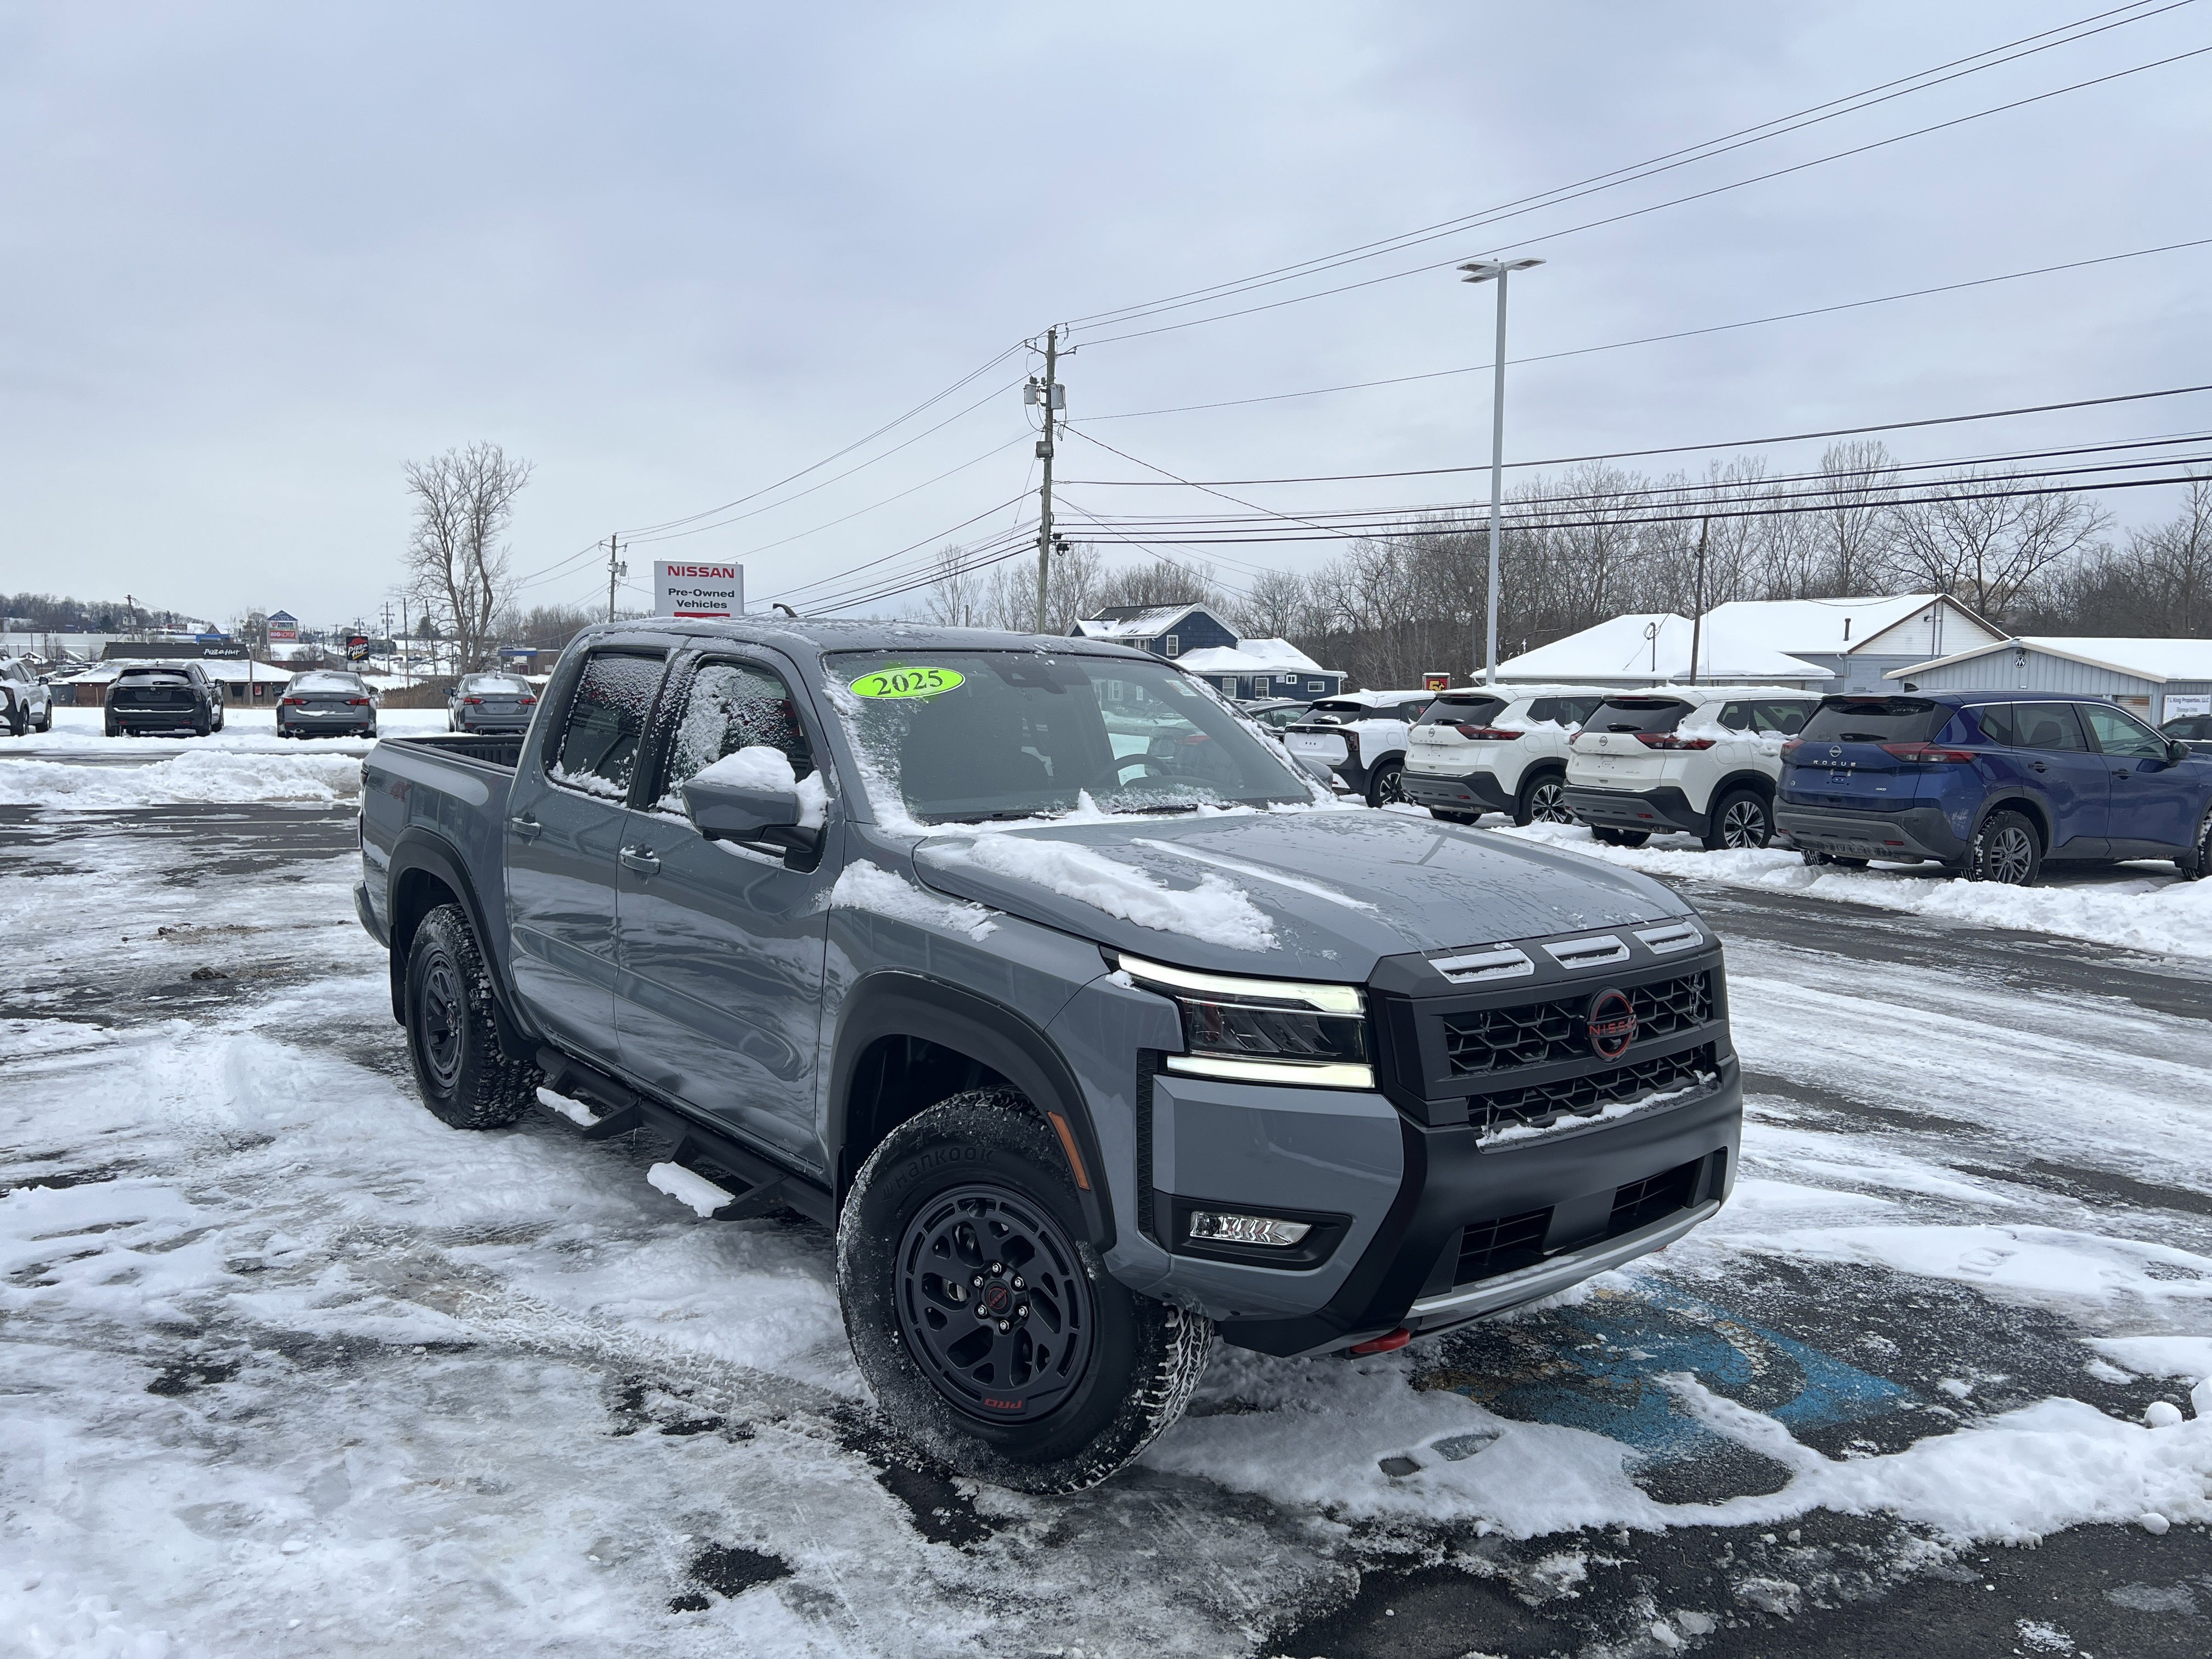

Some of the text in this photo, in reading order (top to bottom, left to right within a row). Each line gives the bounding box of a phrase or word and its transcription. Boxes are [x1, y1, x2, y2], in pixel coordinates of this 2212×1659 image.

[668, 565, 735, 578] NISSAN
[668, 588, 735, 597] Pre-Owned
[676, 600, 727, 608] Vehicles
[347, 643, 368, 656] Pizza
[351, 648, 366, 658] Hut
[872, 670, 943, 696] 2025
[984, 1398, 1023, 1409] PRO
